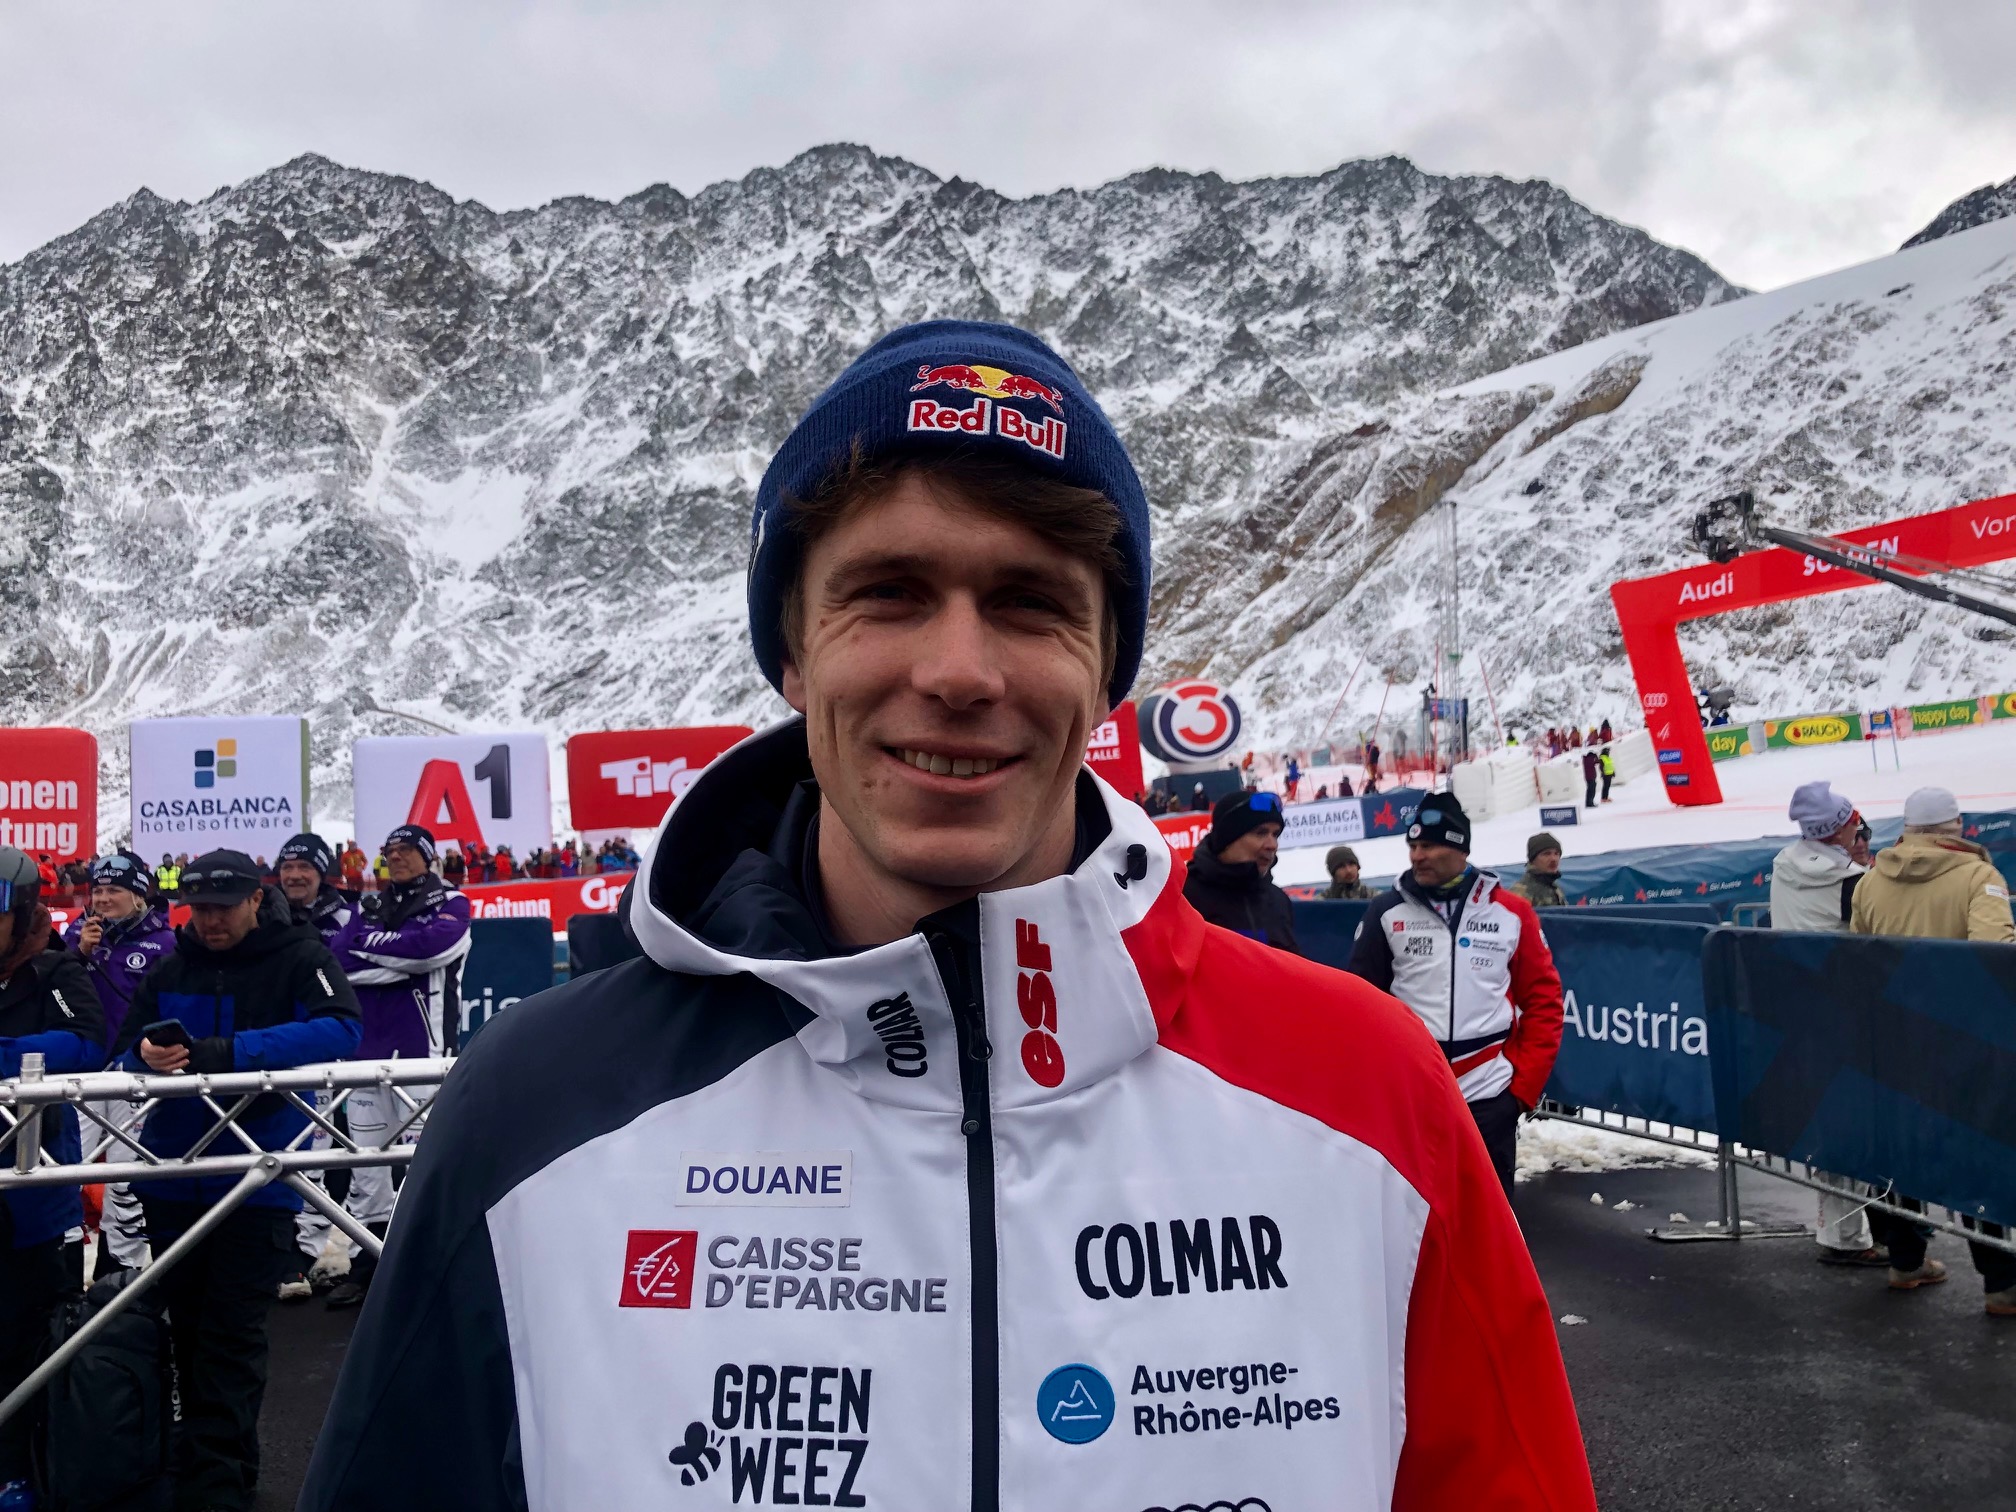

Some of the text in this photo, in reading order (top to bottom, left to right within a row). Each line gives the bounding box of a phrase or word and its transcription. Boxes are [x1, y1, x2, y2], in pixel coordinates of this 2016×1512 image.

[909, 399, 1067, 458] Red Bull
[1678, 571, 1734, 605] Audi
[1801, 722, 1842, 738] RAUCH
[1912, 704, 1970, 728] happy day
[1711, 733, 1736, 754] day
[140, 796, 292, 819] CASABLANCA
[405, 744, 512, 851] A1
[140, 813, 293, 834] hotelsoftware
[1284, 809, 1358, 828] ASABLANCA
[1660, 887, 1683, 898] Austria
[1466, 920, 1499, 933] COLMAR
[867, 991, 928, 1077] COLMAR
[1561, 989, 1709, 1057] Austria
[686, 1165, 842, 1194] DOUANE
[707, 1235, 863, 1271] CAISSE
[1075, 1215, 1288, 1300] COLMAR
[705, 1274, 948, 1312] D'EPARGNE
[1131, 1362, 1299, 1395] Auvergne-
[712, 1363, 872, 1434] GREEN
[1133, 1394, 1340, 1435] Rhône-Alpes
[730, 1436, 869, 1507] WEEZ
